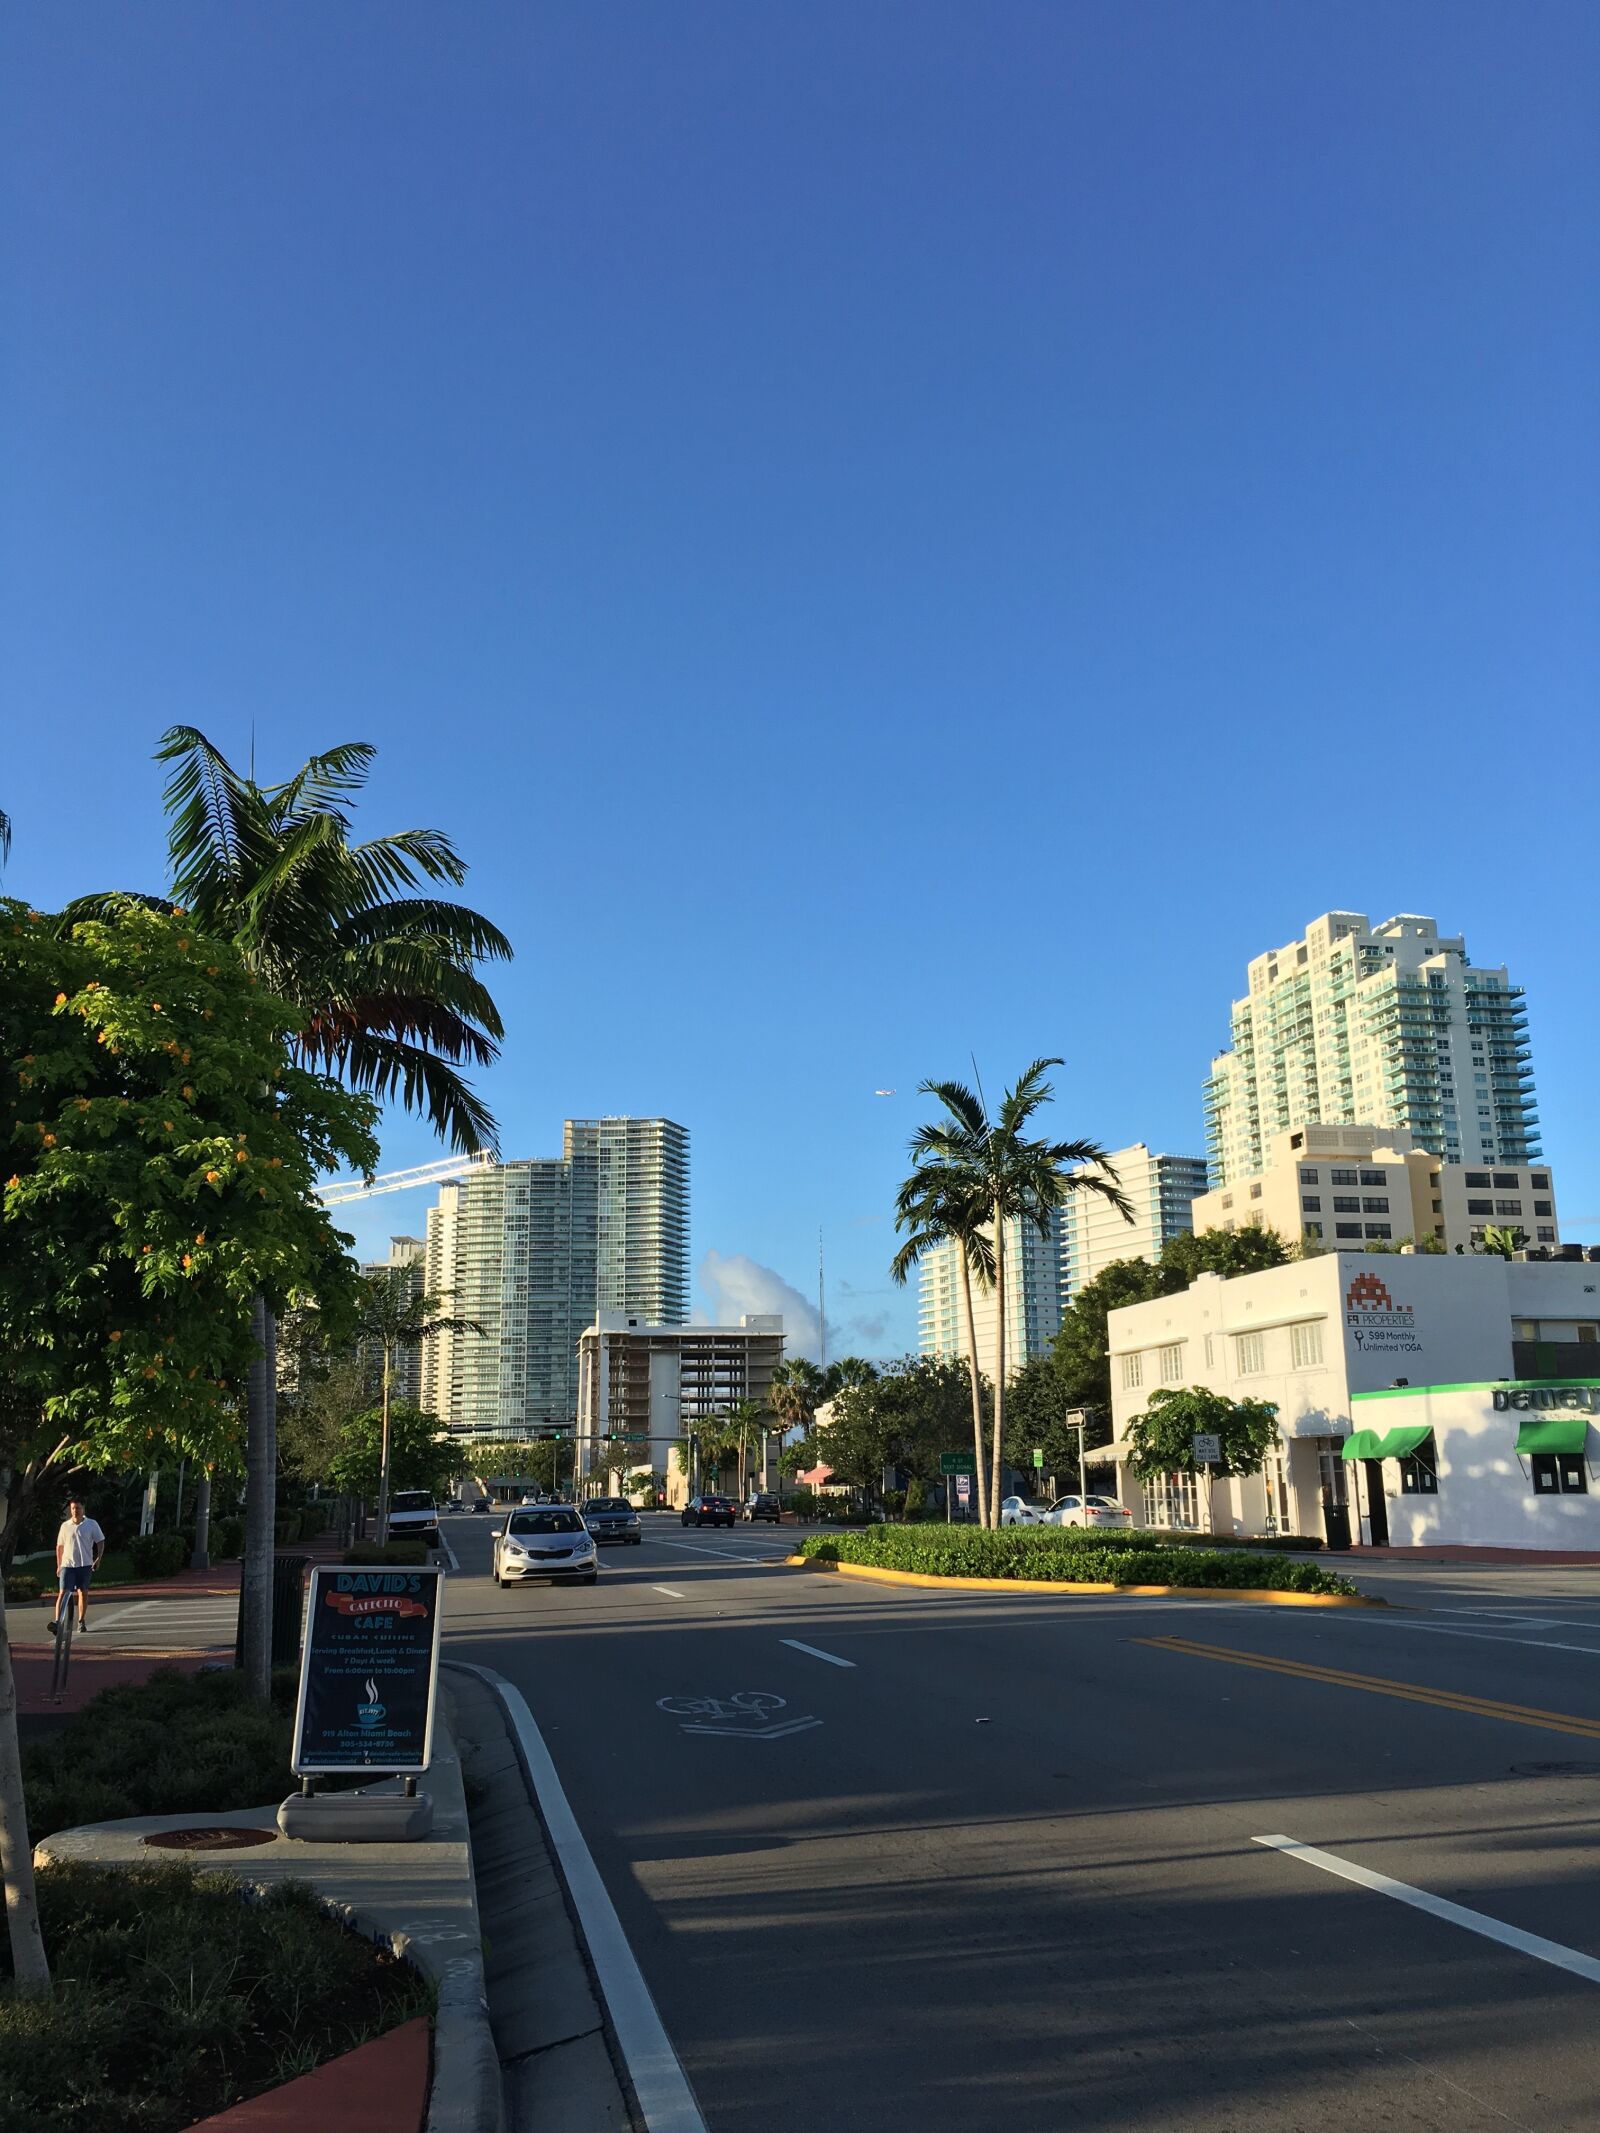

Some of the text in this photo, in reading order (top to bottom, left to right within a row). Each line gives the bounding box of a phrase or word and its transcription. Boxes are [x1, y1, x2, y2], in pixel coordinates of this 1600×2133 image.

[1363, 1314, 1415, 1326] PROPERTIES
[1368, 1331, 1416, 1343] $99 Monthly
[1363, 1343, 1424, 1352] Unlimited YOGA
[1491, 1388, 1600, 1415] Dewey
[336, 1574, 421, 1592] DAVID'S
[349, 1599, 403, 1612] CAFECITO
[354, 1616, 394, 1629] CAFE
[406, 1647, 430, 1655] Dinner
[324, 1667, 344, 1675] From
[337, 1729, 360, 1738] Alton
[361, 1729, 386, 1738] Miami
[387, 1729, 412, 1738] Beach
